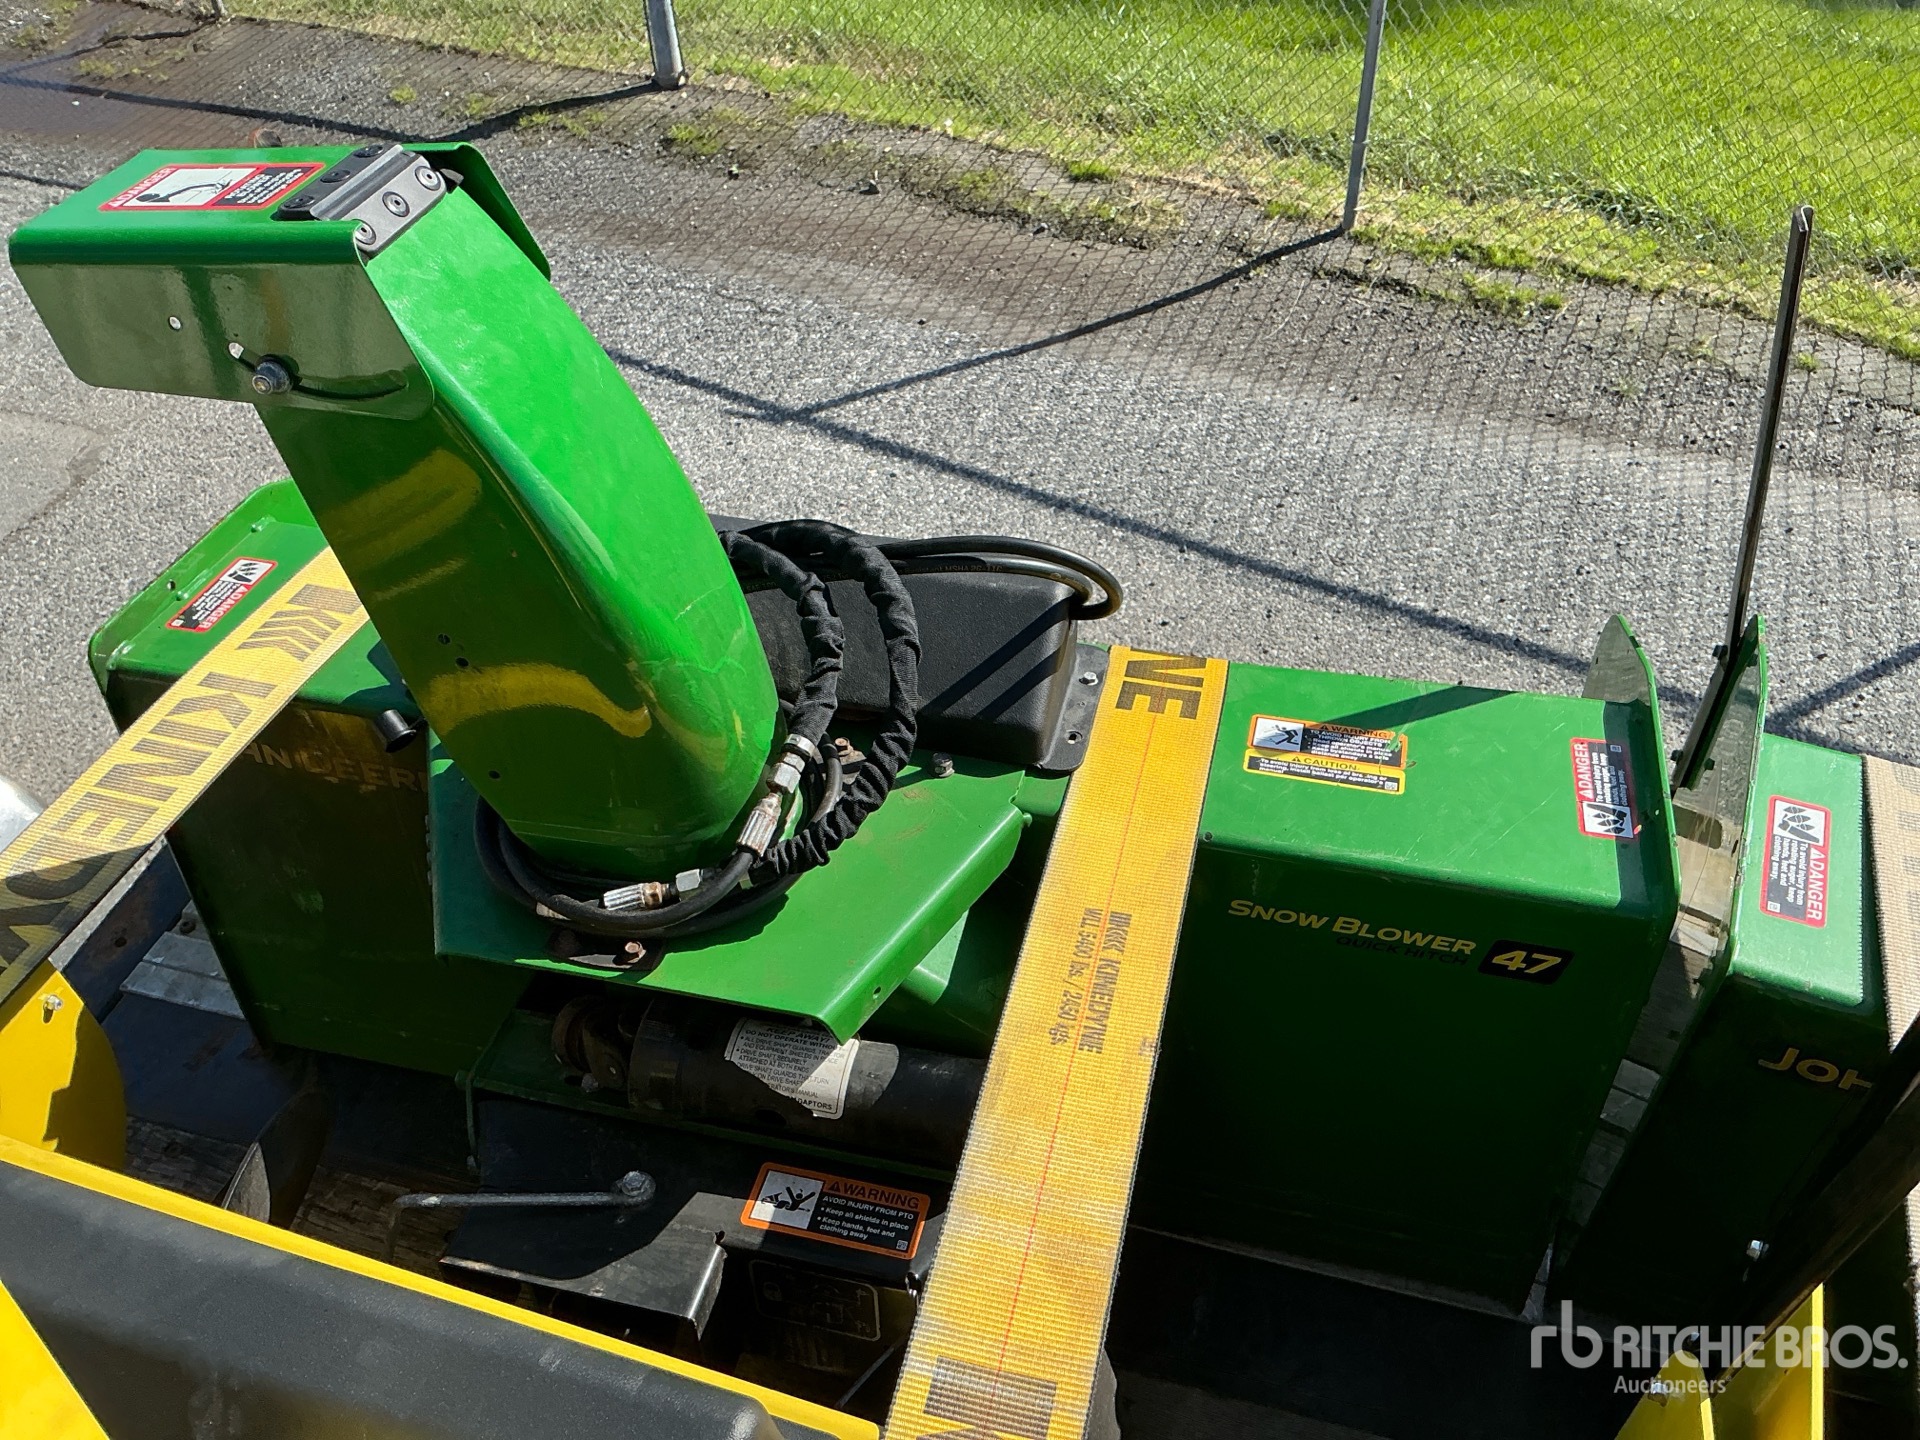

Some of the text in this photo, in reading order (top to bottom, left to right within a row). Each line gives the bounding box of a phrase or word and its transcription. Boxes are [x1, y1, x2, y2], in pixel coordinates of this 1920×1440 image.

[199, 592, 243, 628] DANGER
[1331, 725, 1388, 739] WARNING
[297, 751, 428, 792] DEER
[1303, 757, 1357, 770] CAUTION
[1574, 743, 1591, 788] DANGER
[1806, 859, 1824, 920] DANGER
[1228, 899, 1477, 955] SNOW BLOWER
[1491, 949, 1562, 974] 47
[774, 1034, 807, 1045] OPERATE
[822, 1195, 914, 1220] AVOID INJURY FROM PTO
[842, 1182, 920, 1209] WARNING
[818, 1223, 868, 1240] clothing away
[821, 1217, 895, 1237] Keep hands, feet and
[824, 1207, 844, 1217] Keep
[854, 1213, 880, 1223] shields
[889, 1221, 909, 1231] place
